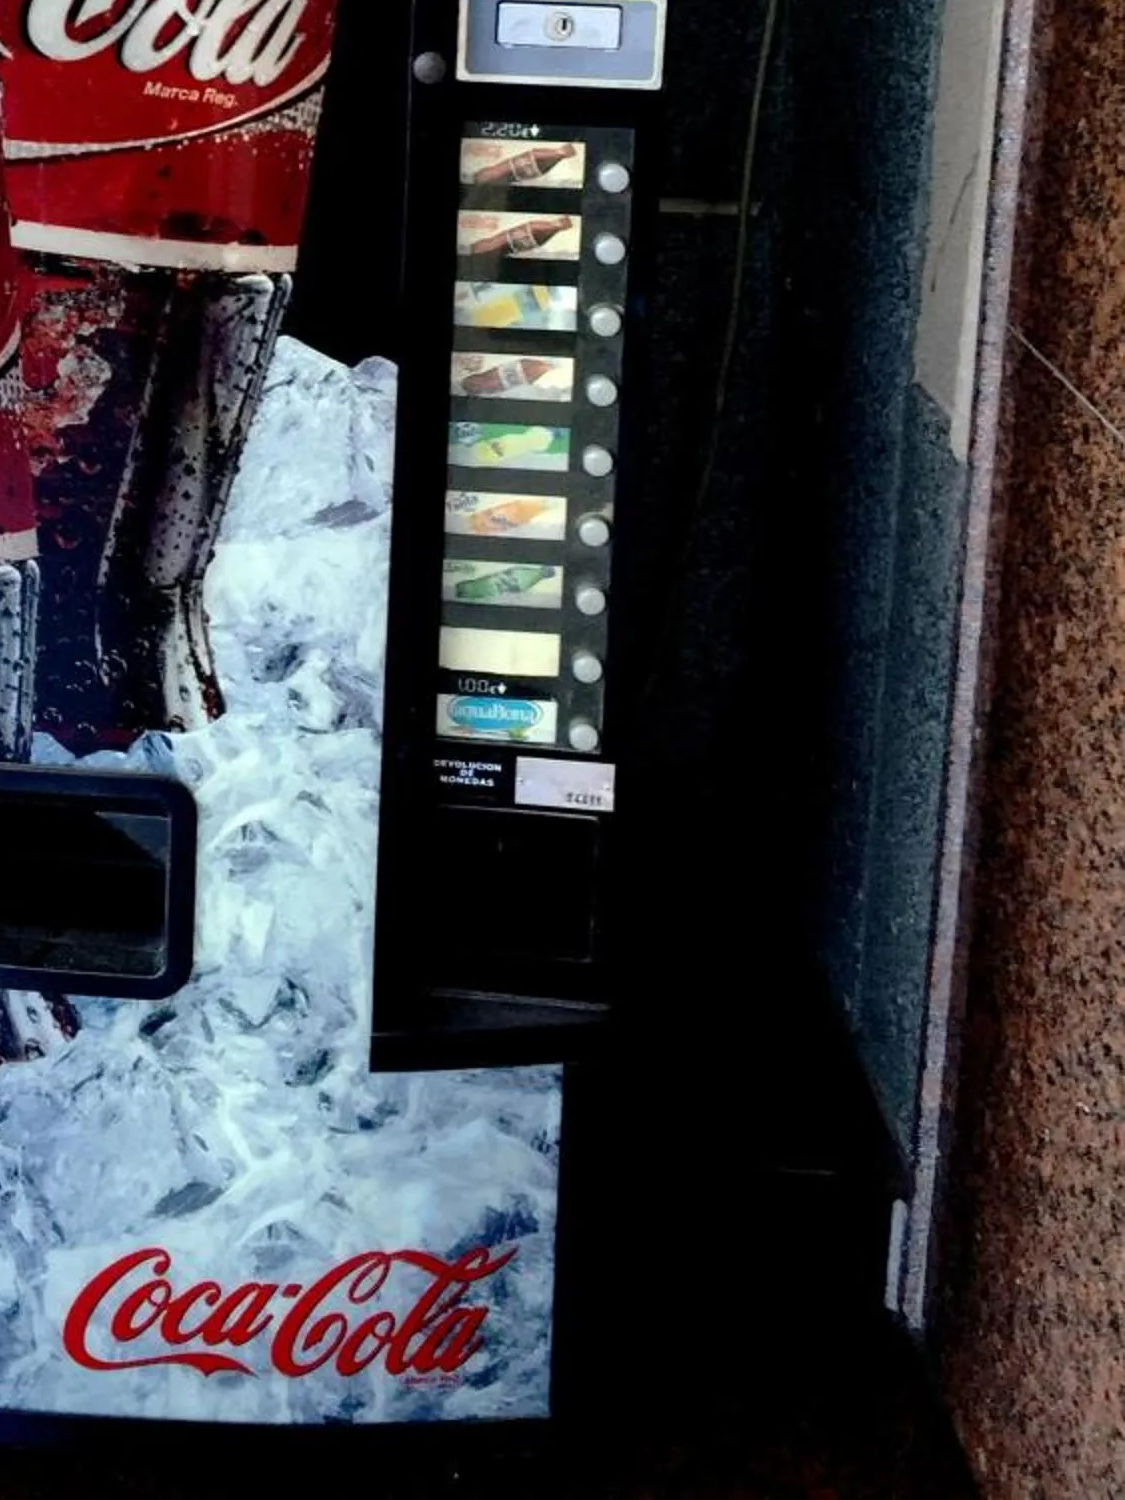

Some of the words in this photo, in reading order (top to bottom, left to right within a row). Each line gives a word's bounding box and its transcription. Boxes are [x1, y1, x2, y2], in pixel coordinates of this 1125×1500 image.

[143, 81, 200, 103] Marca
[201, 86, 241, 107] Reg.
[439, 775, 495, 787] MONEDAS
[459, 769, 474, 777] DE
[62, 1246, 520, 1380] Coca-Cola
